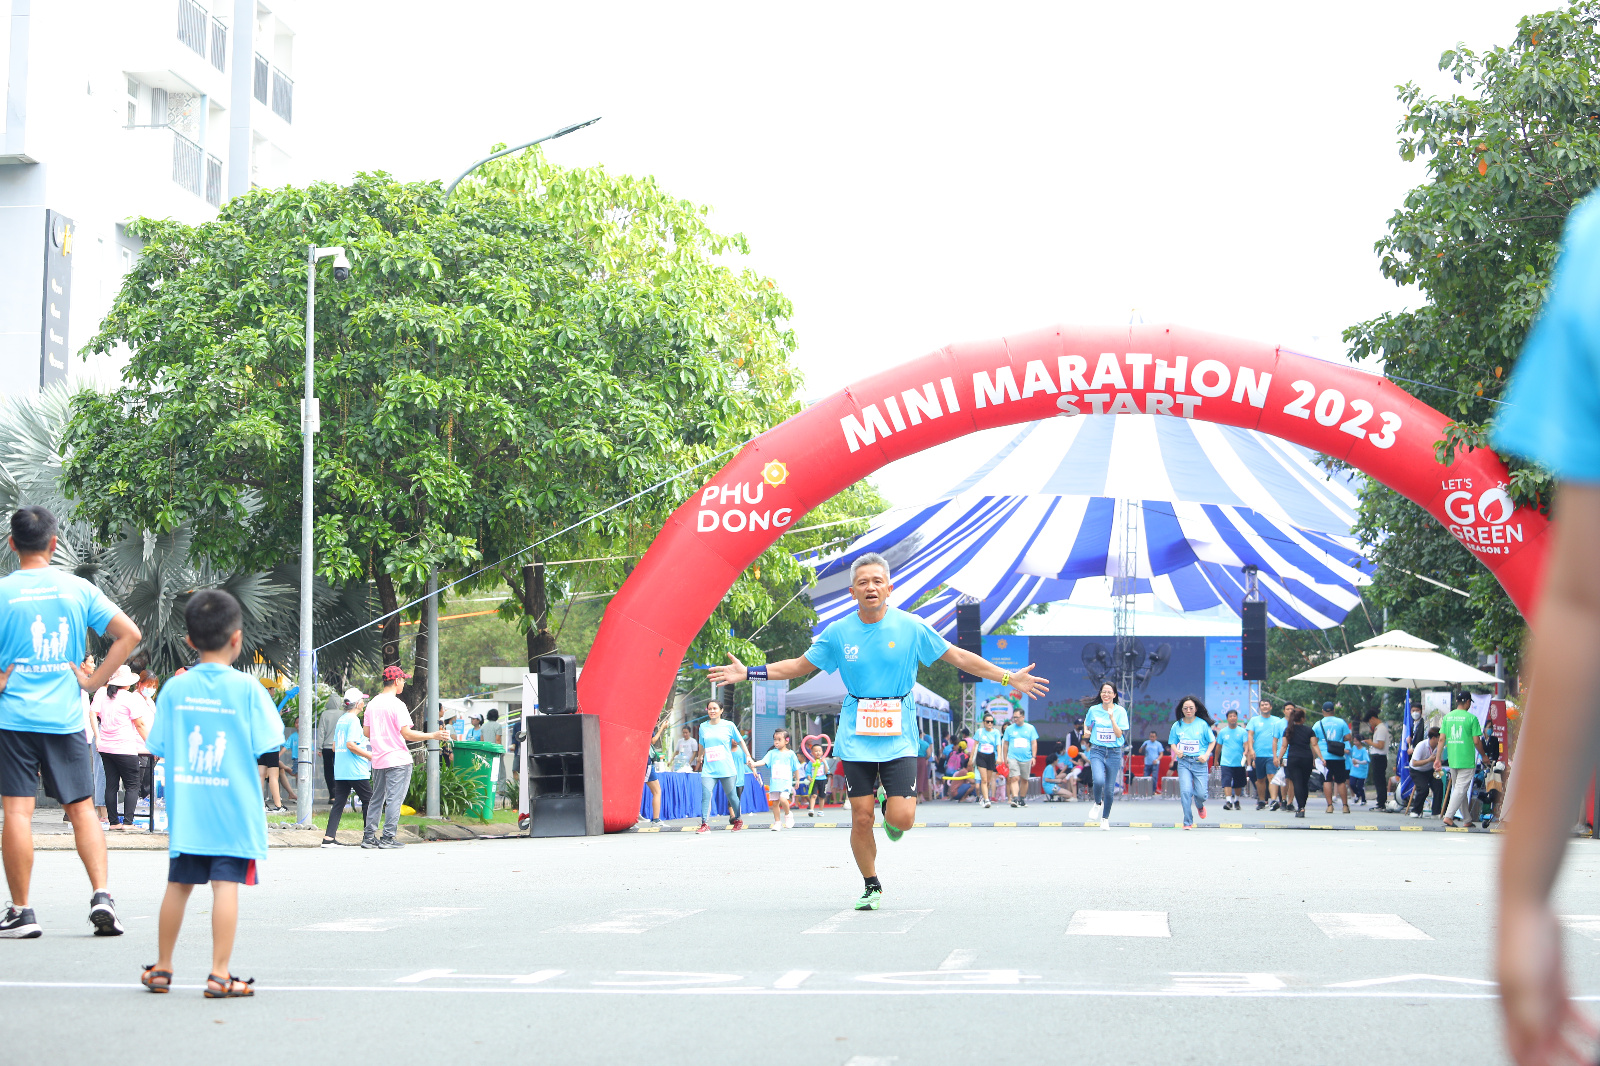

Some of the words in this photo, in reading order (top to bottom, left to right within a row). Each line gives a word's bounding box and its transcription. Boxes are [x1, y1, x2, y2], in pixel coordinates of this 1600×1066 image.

[839, 376, 961, 454] MINI
[972, 352, 1273, 410] MARATHON
[1282, 379, 1403, 450] 2023
[1055, 392, 1203, 419] START
[700, 481, 764, 507] PHU
[1441, 478, 1473, 491] LET'S
[1444, 487, 1514, 526] GO
[697, 507, 793, 533] DONG
[1448, 523, 1524, 545] GREEN
[1466, 542, 1501, 554] SEASON
[1503, 546, 1510, 554] 3
[1221, 700, 1240, 710] GO
